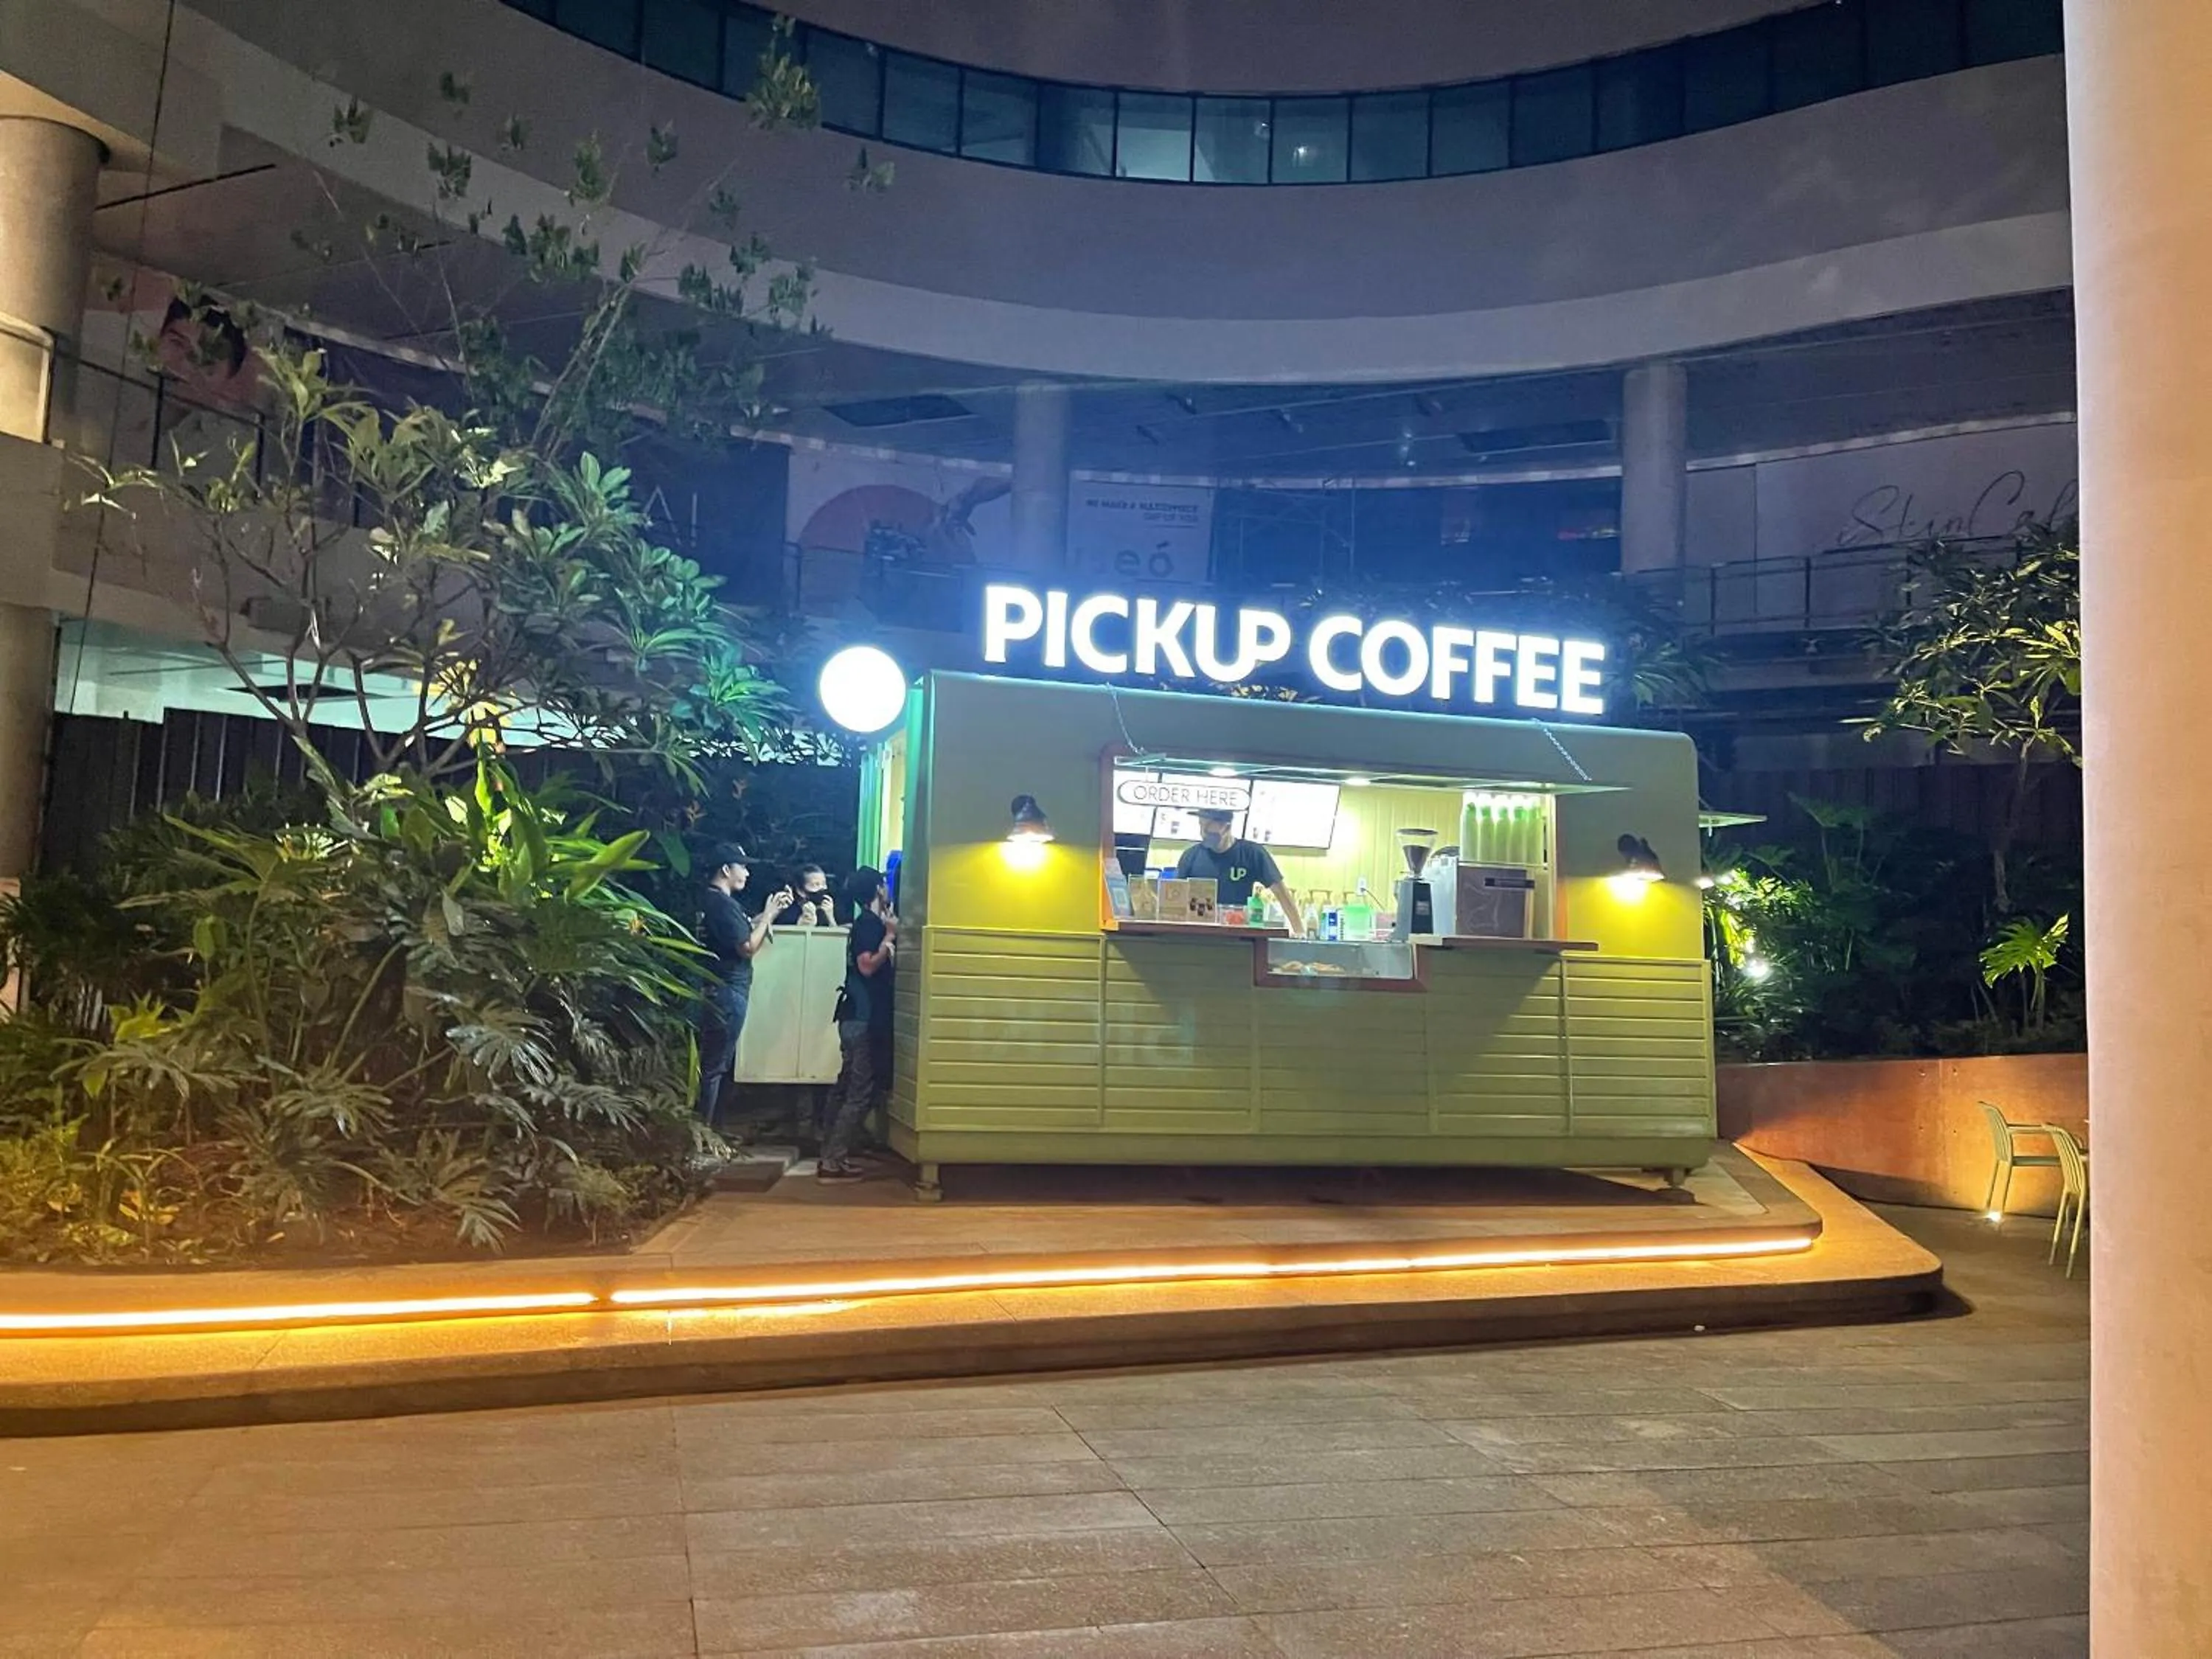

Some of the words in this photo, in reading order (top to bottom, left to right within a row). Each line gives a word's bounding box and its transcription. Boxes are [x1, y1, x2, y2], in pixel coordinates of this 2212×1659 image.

[984, 585, 1291, 683] PICKUP
[1309, 615, 1606, 714] COFFEE
[1133, 785, 1191, 803] ORDER
[1197, 789, 1237, 807] HERE
[1230, 866, 1247, 881] UP
